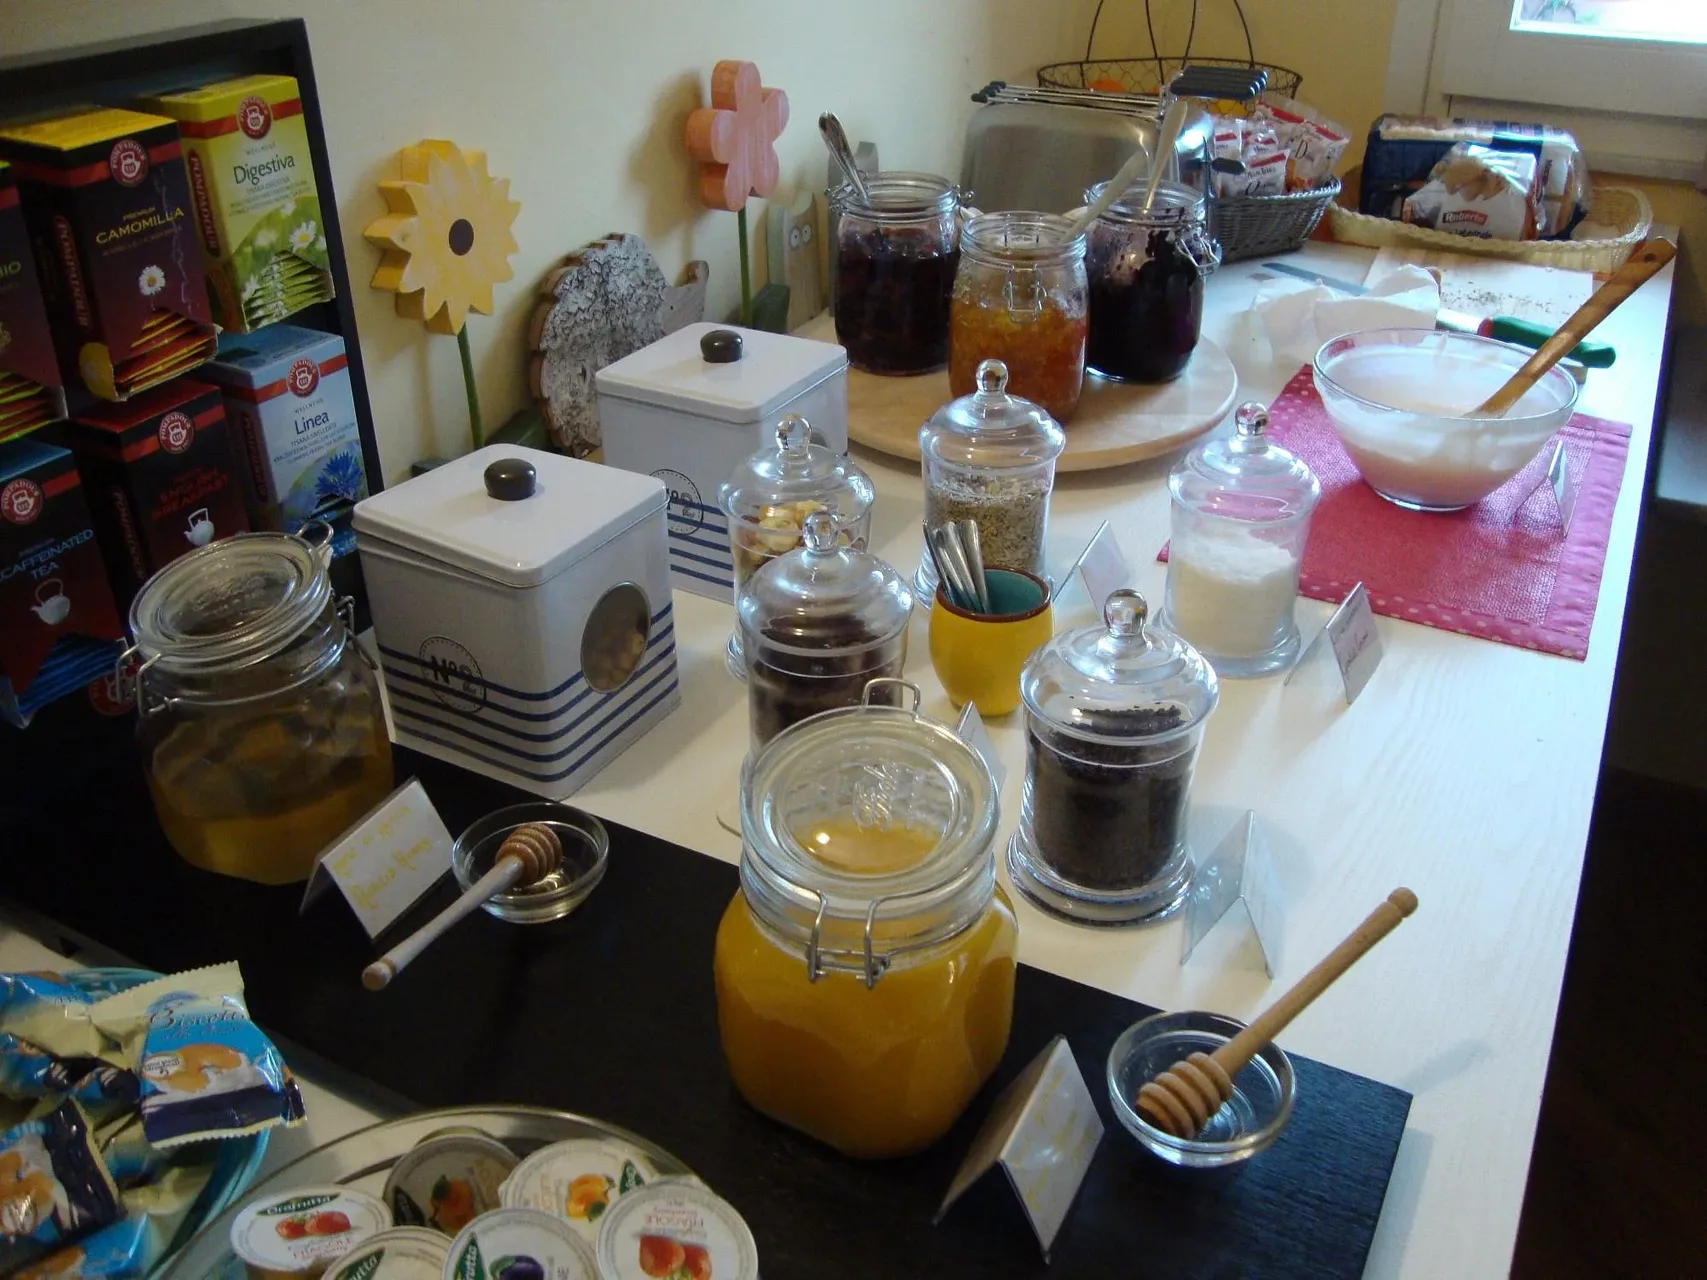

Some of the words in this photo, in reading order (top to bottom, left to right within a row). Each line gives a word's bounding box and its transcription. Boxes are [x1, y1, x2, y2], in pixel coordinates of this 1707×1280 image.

[233, 155, 296, 186] Digestiva
[95, 207, 184, 245] CAMOMILLA
[294, 410, 330, 435] Linea
[30, 561, 60, 580] TEA
